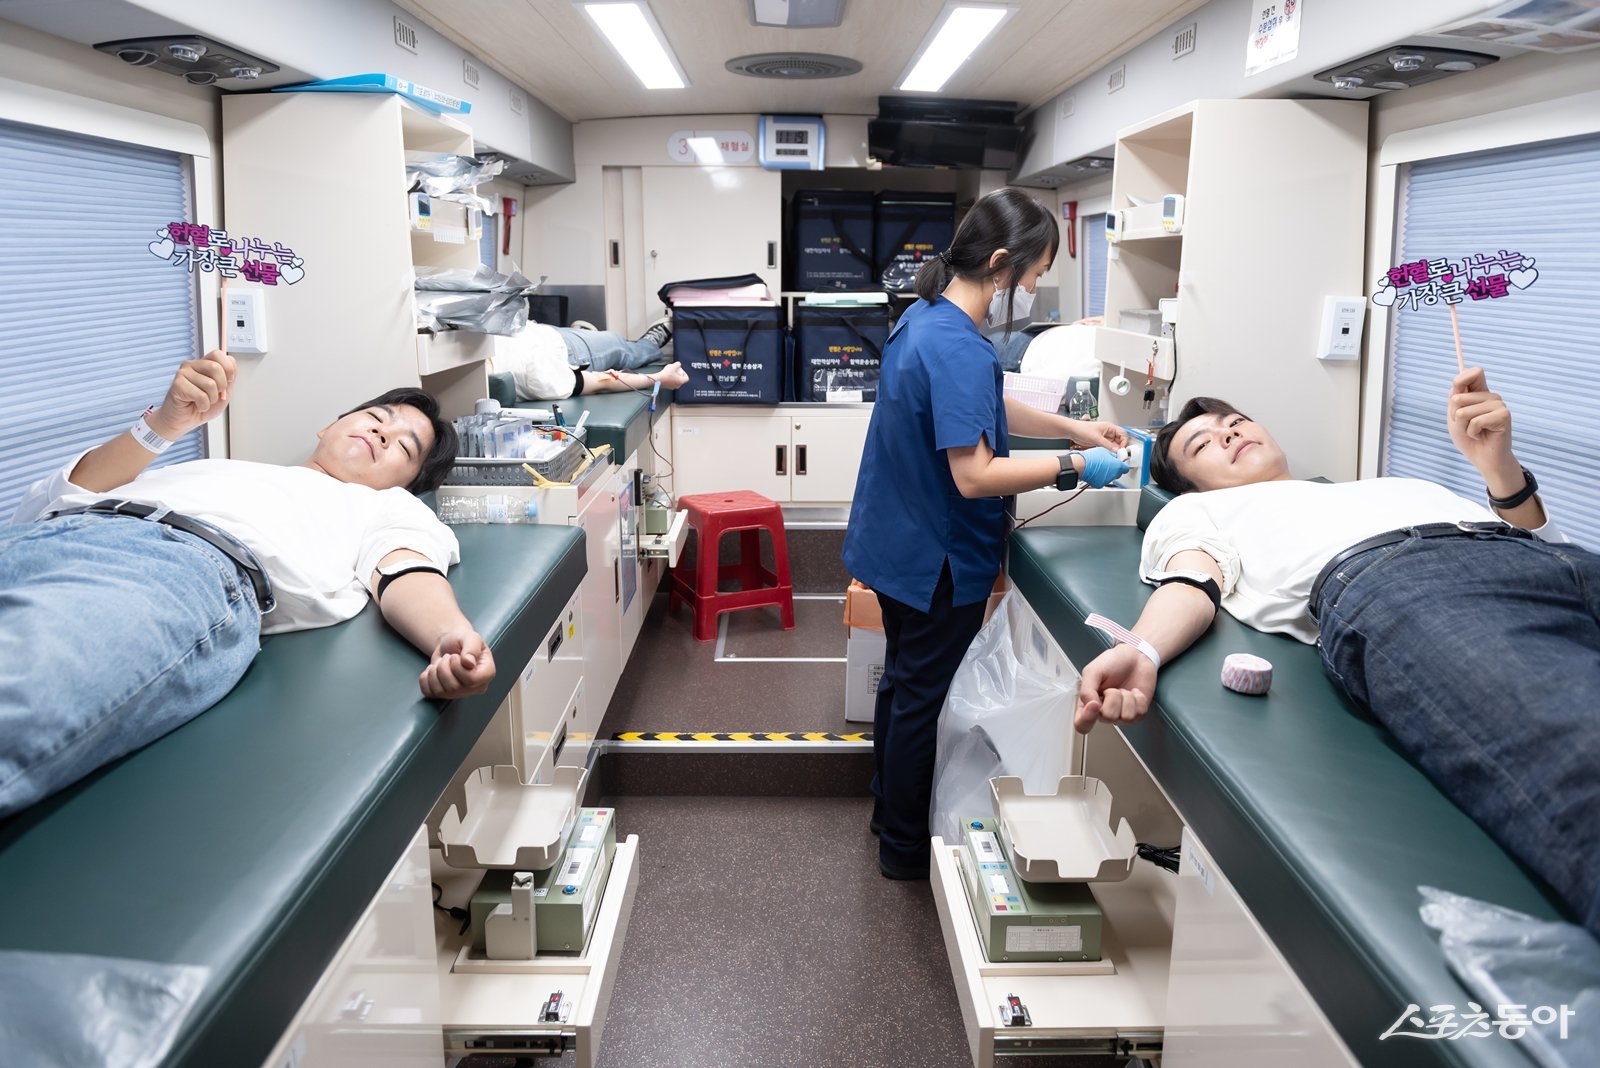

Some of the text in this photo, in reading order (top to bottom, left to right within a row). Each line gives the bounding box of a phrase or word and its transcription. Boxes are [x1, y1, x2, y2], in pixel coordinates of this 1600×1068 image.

[678, 138, 688, 155] 3
[167, 222, 295, 264] 헌혈로 나누는
[173, 249, 280, 285] 가장 큰 선물
[1387, 250, 1525, 288] 헌혈로 나누는
[1397, 273, 1510, 312] 가장 큰 선물
